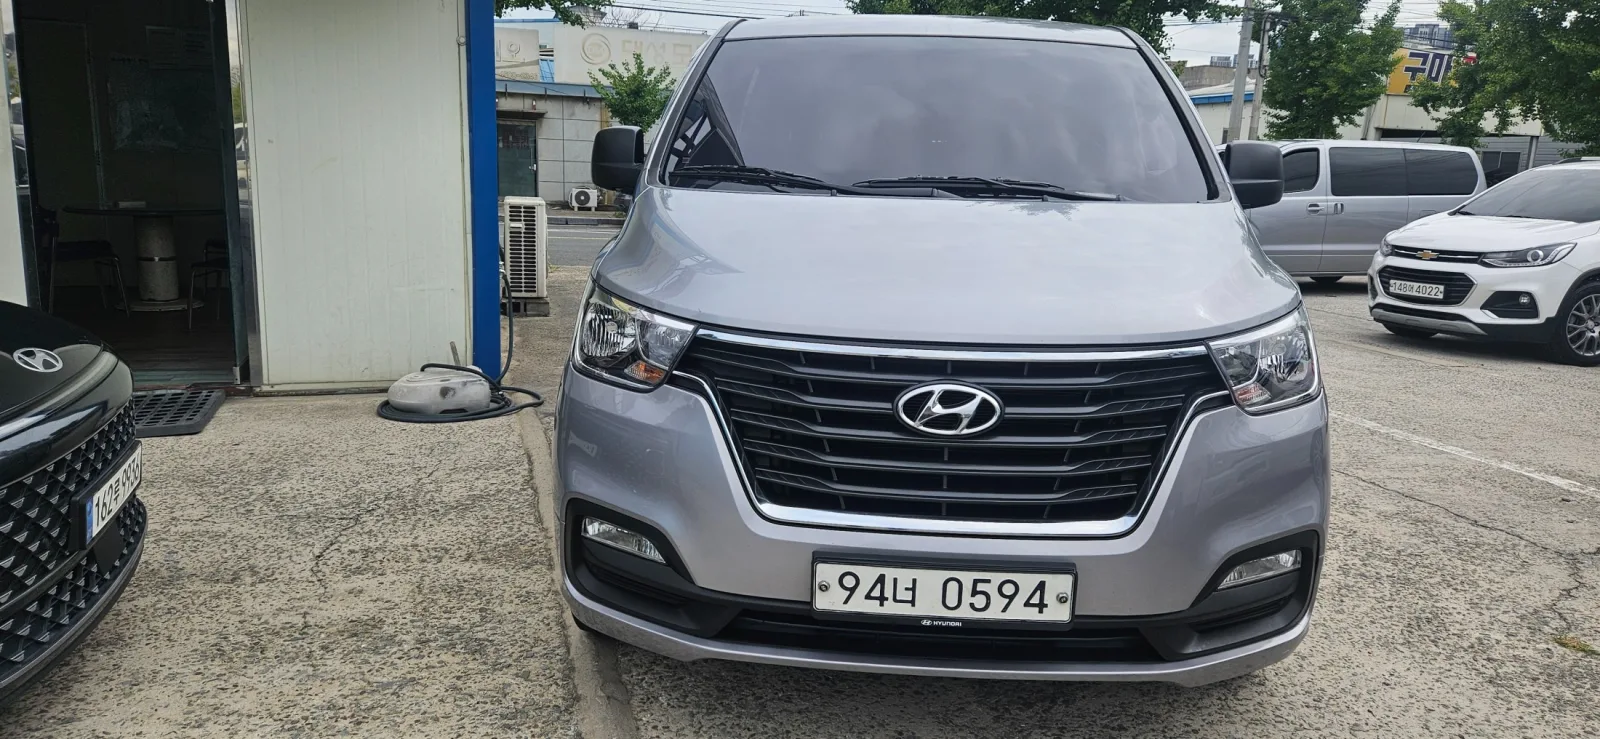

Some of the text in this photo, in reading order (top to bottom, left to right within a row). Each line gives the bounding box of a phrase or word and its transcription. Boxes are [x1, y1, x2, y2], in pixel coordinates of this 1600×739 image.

[621, 38, 701, 69] 대성모
[1415, 284, 1440, 297] 4022
[95, 477, 120, 528] 162루
[837, 571, 1049, 615] 94너 0594
